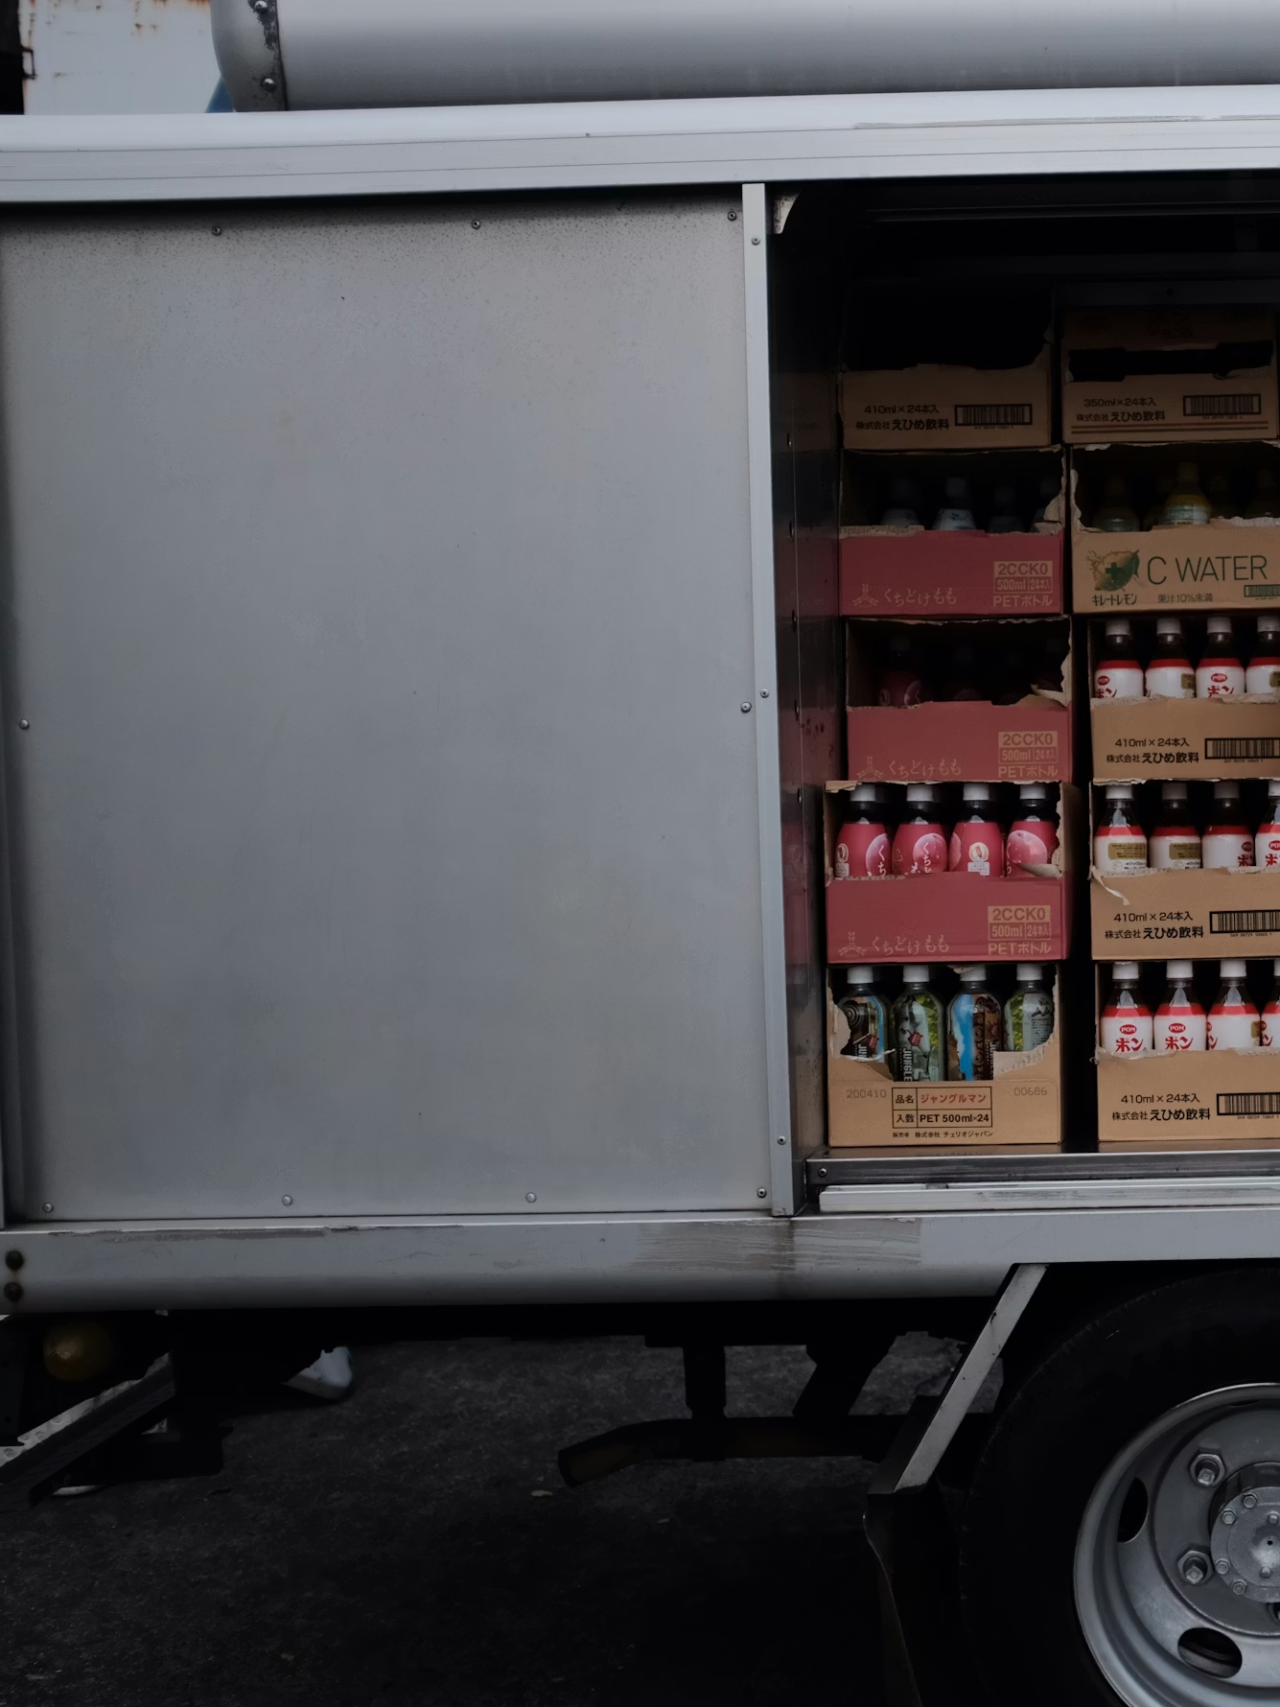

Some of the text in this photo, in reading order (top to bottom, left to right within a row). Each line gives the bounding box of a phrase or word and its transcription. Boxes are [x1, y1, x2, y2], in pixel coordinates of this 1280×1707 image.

[1147, 555, 1268, 585] C WATER
[997, 578, 1026, 590] 500ml
[884, 587, 957, 607] くちどけもも
[993, 595, 1052, 608] PETボトル
[1092, 594, 1137, 607] キレートレモン
[1158, 593, 1214, 603] 果汁10%未満
[1002, 749, 1031, 761] 500ml
[1106, 752, 1199, 764] 株式会社えひめ飲料
[888, 758, 961, 779] くちどけもも
[998, 765, 1058, 778] PETボトル
[992, 925, 1022, 937] 500ml
[1105, 926, 1204, 939] 株式会社えひめ飲料
[871, 935, 949, 955] くちどけもも
[988, 943, 1051, 955] PETボトル
[1120, 1025, 1136, 1033] POM
[1169, 1024, 1185, 1032] POM
[846, 1089, 887, 1099] 200410
[895, 1093, 986, 1104] 品名 ジャングルマン
[896, 1113, 989, 1123] 入数 PET 500ml×24
[1112, 1108, 1210, 1121] 株式会社えひめ飲料
[943, 1130, 993, 1138] チェリオジャパン
